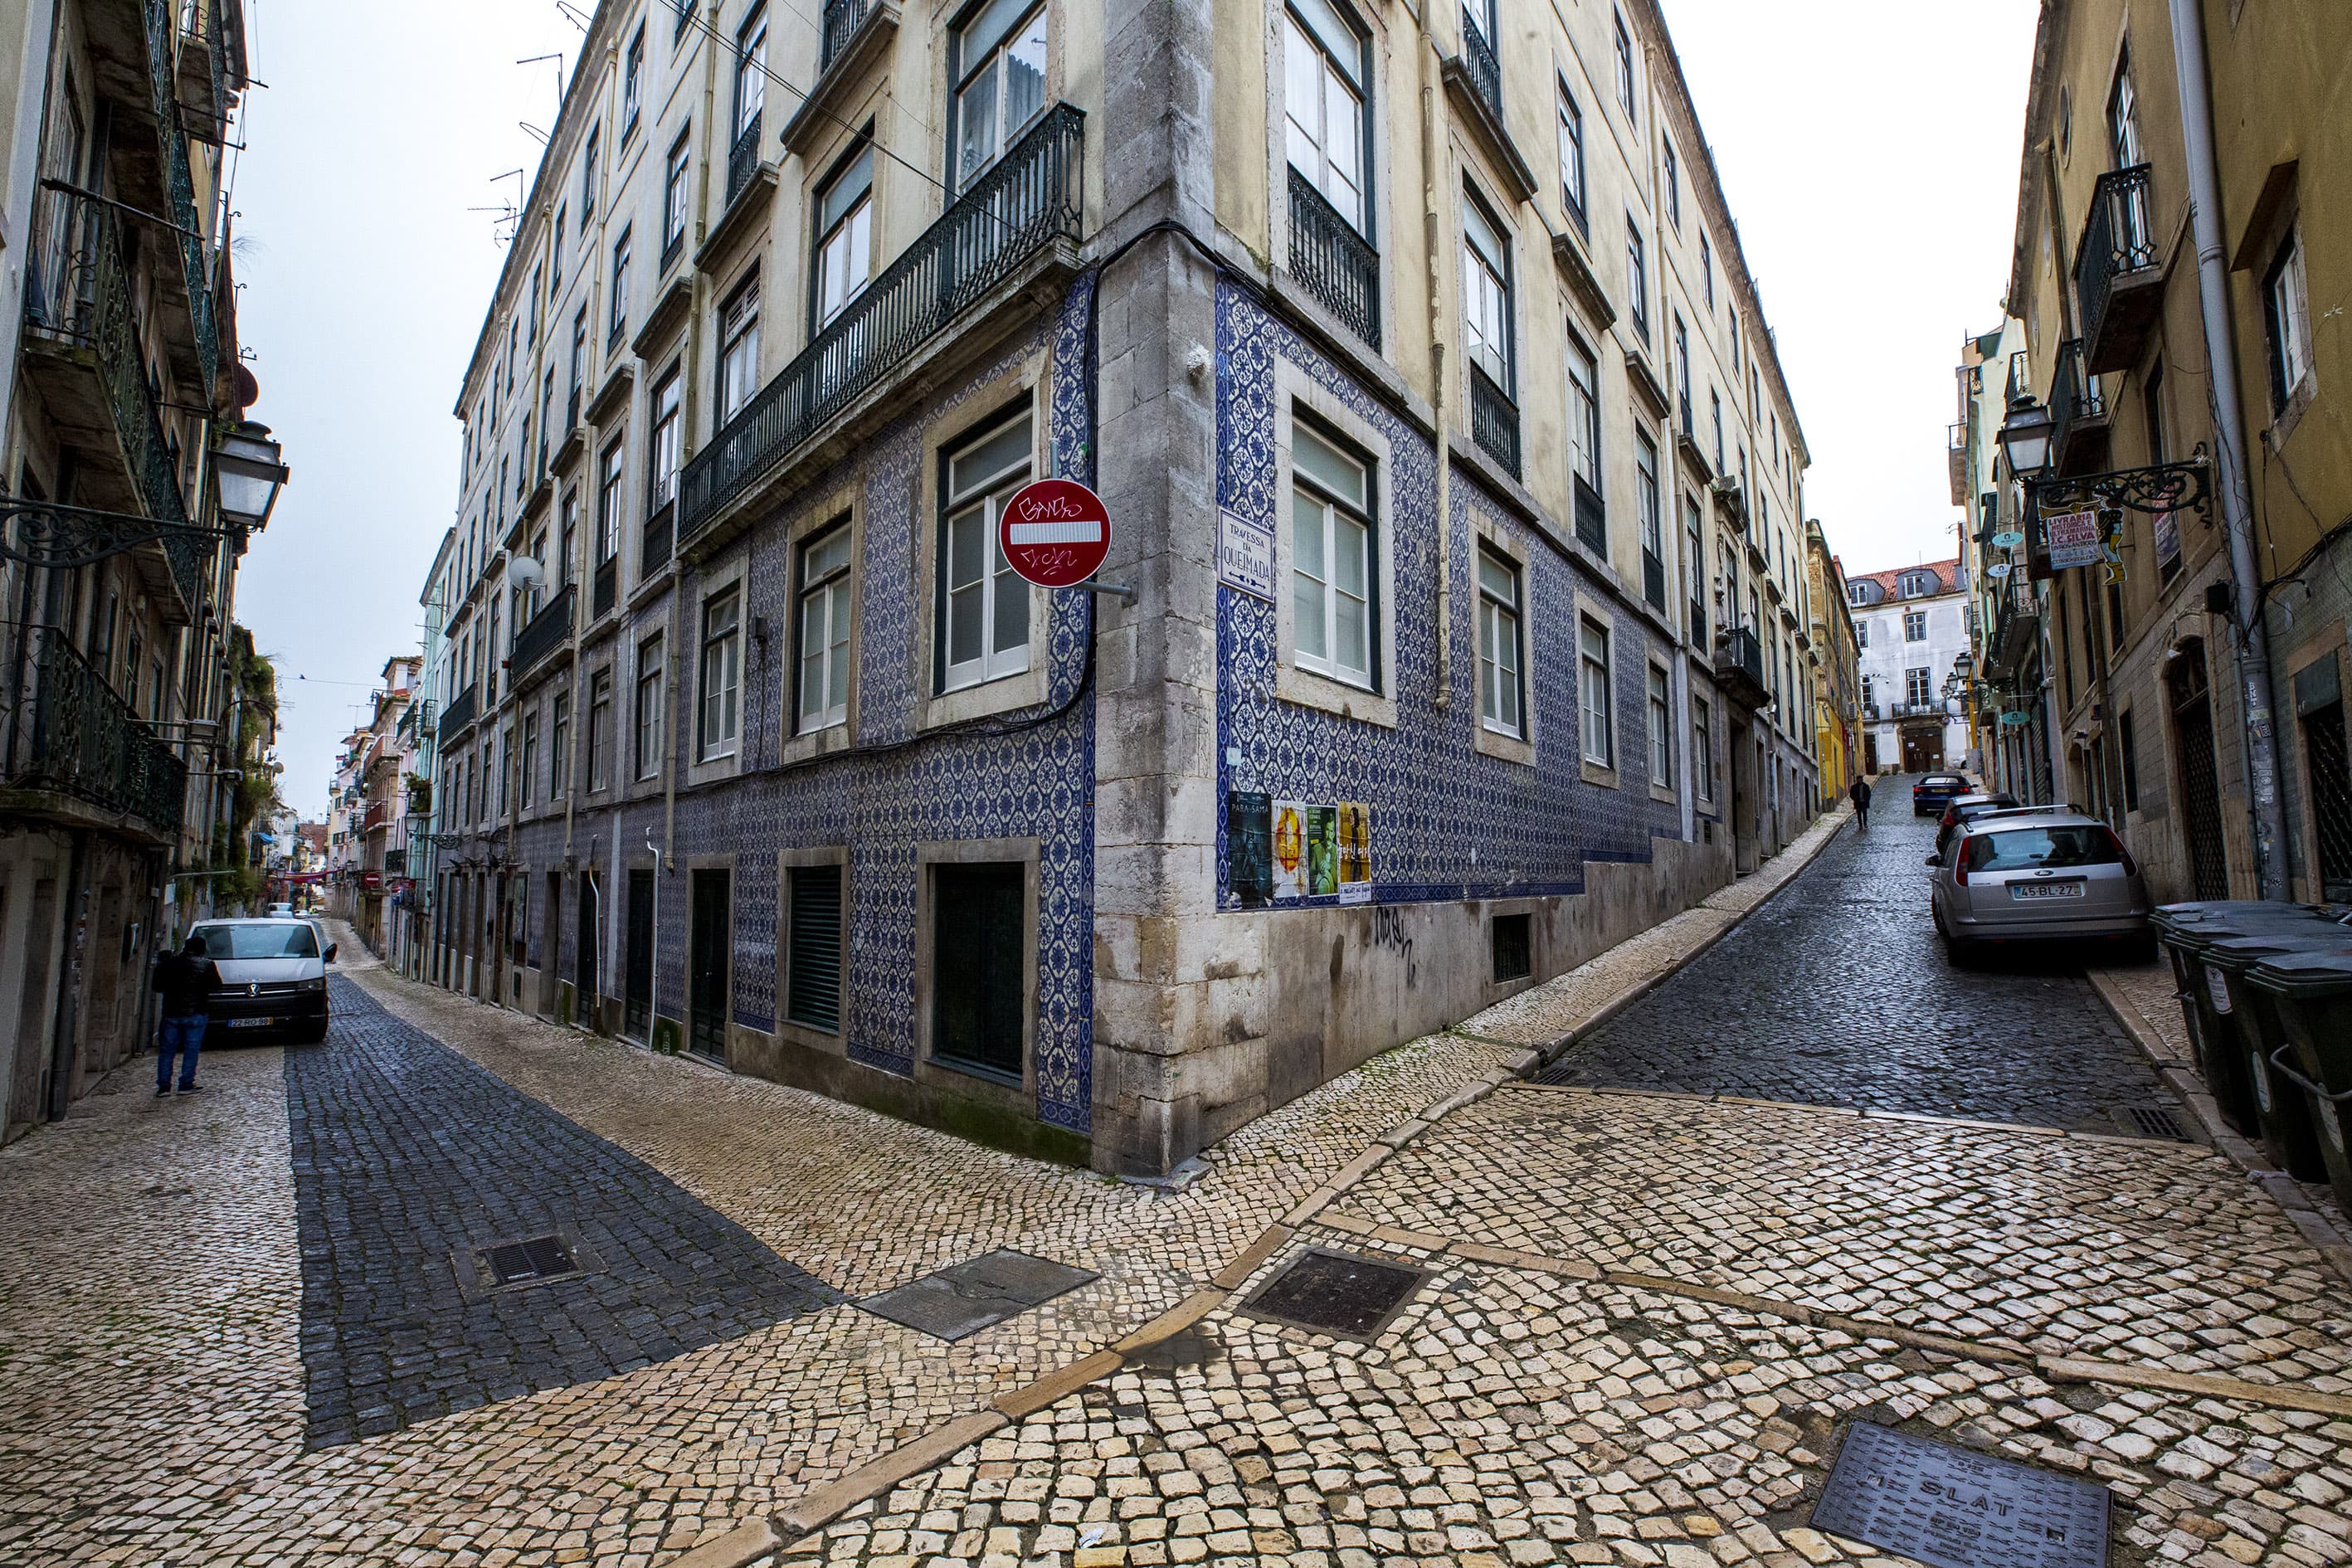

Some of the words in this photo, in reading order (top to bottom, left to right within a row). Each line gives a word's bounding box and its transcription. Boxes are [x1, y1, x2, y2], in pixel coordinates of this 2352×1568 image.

[2048, 513, 2092, 525] LIVRARIA
[1230, 523, 1265, 548] TRAVESSA
[2050, 525, 2096, 538] ULTRAMARINA
[2067, 532, 2096, 543] SILVA
[1243, 543, 1251, 553] DA
[1224, 546, 1270, 582] QUEIMADA
[1231, 803, 1249, 814] PARA
[1251, 804, 1269, 814] SAMA
